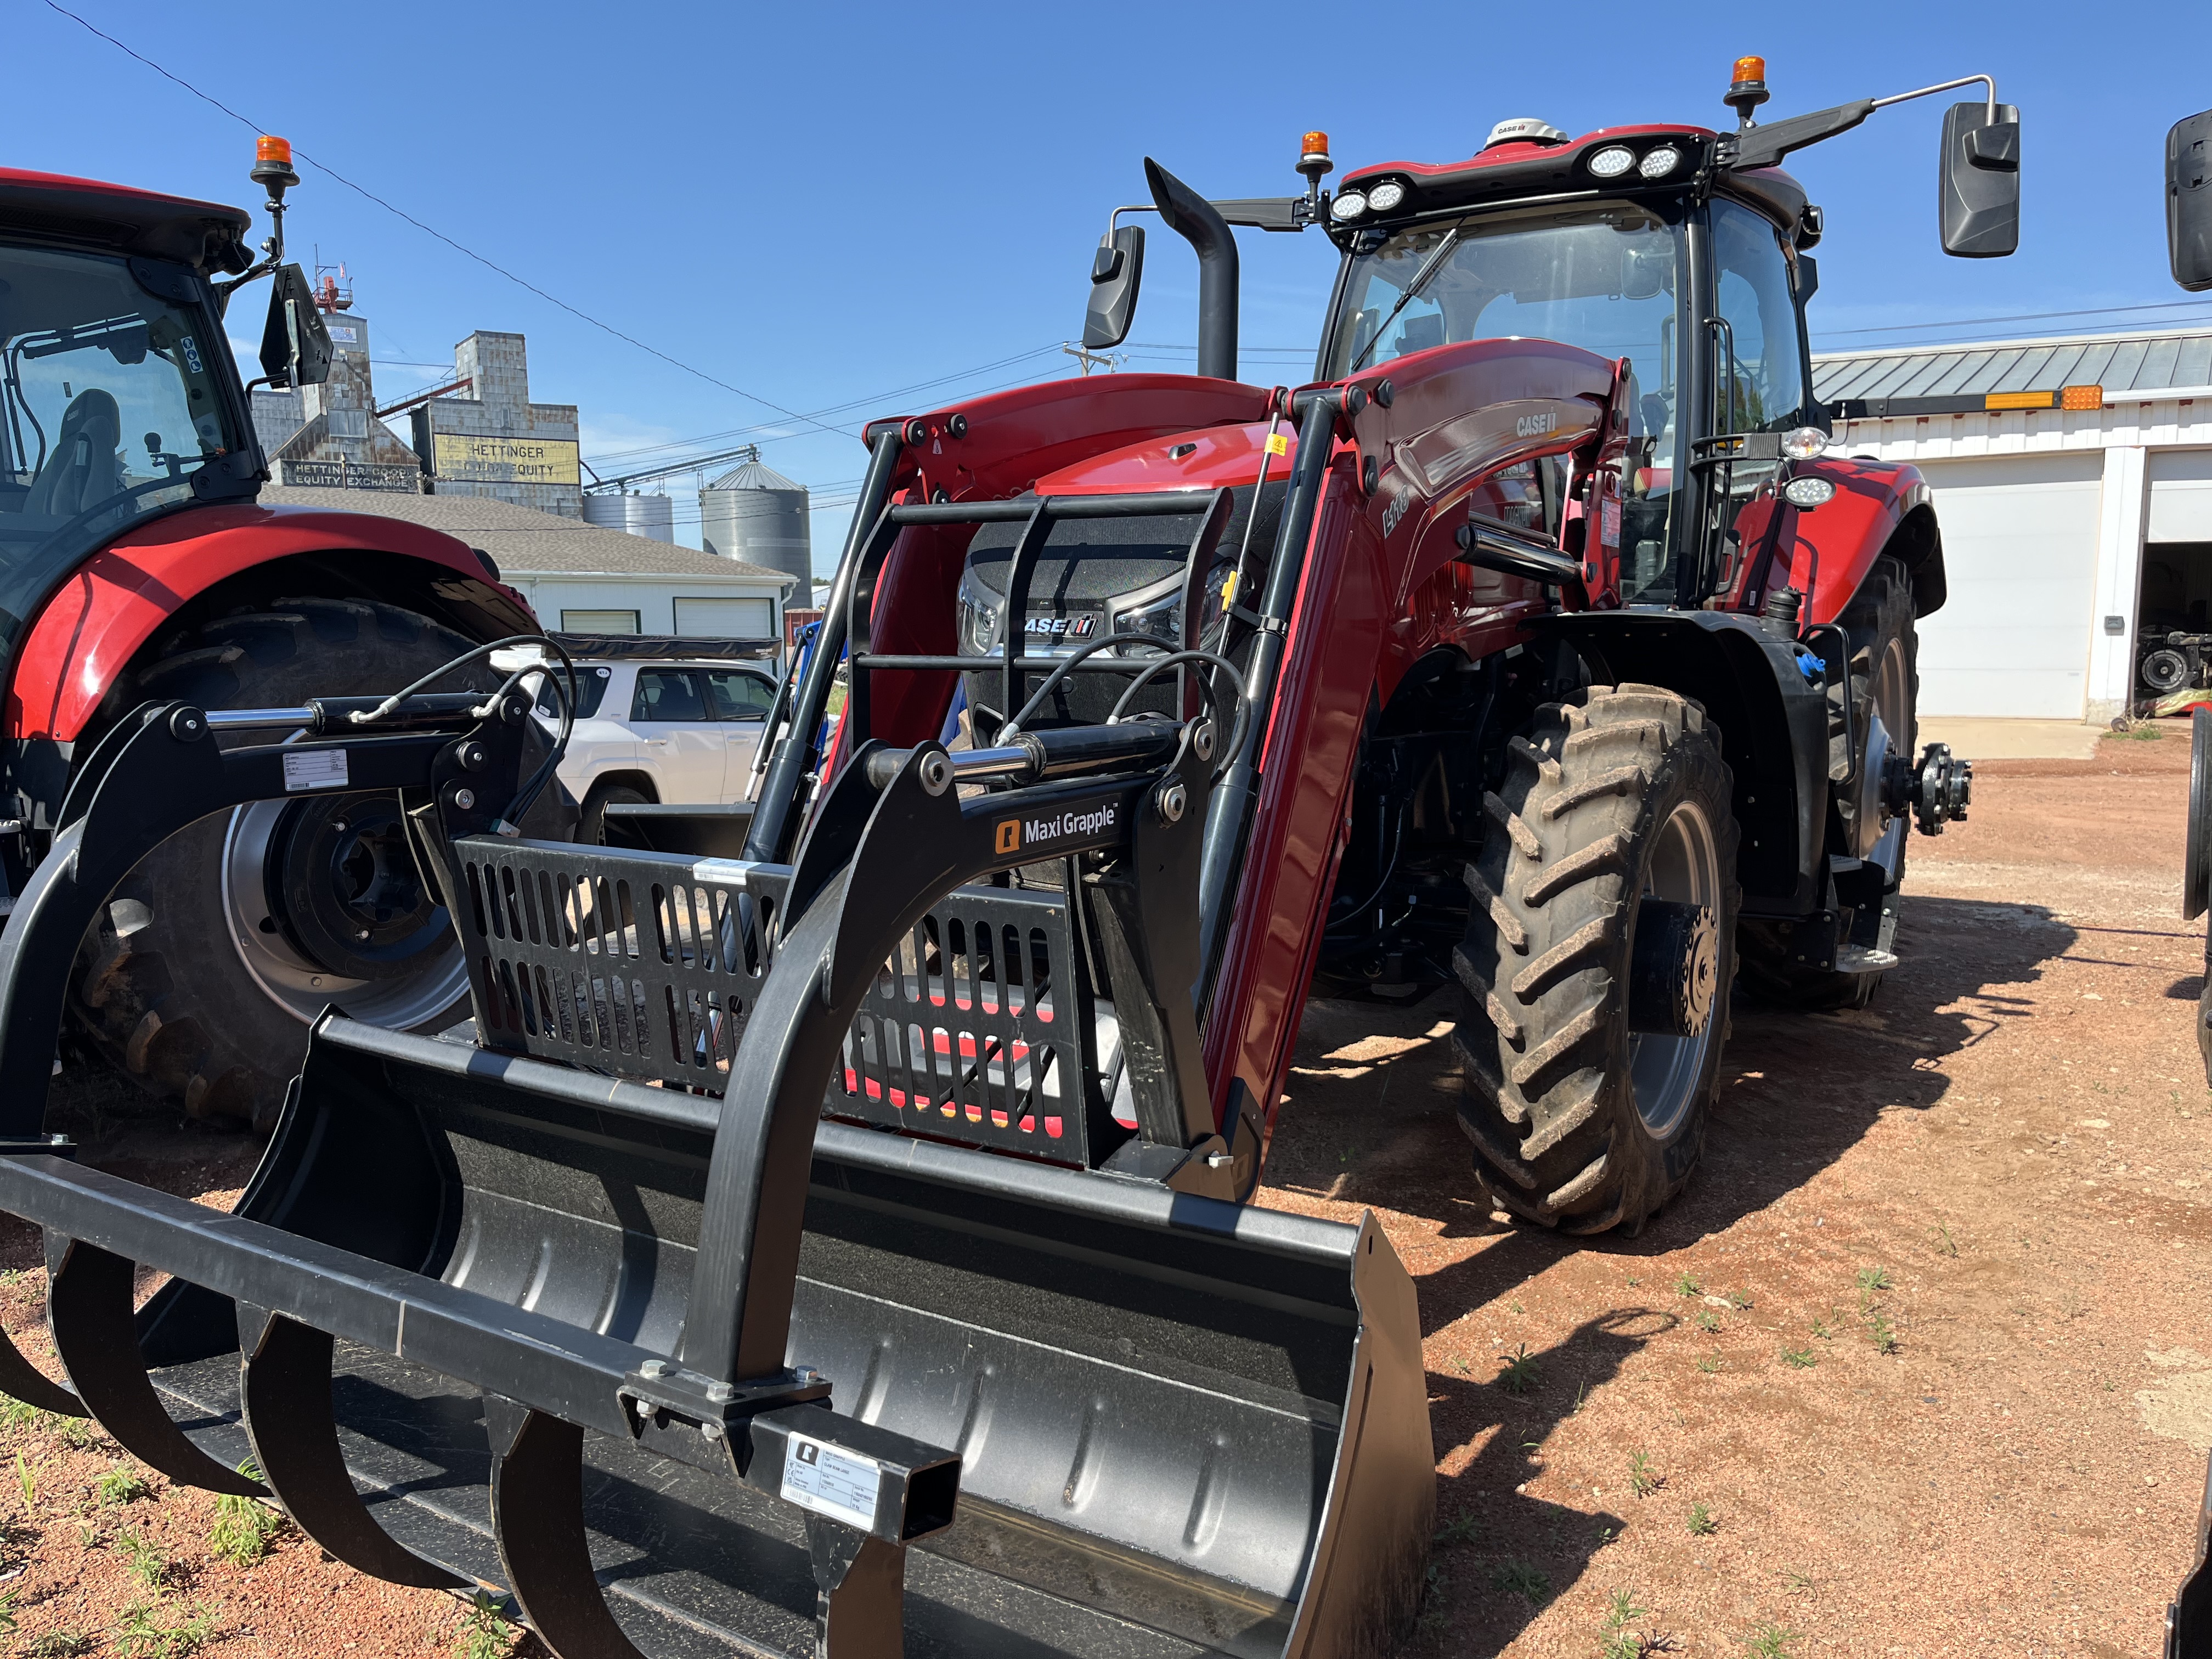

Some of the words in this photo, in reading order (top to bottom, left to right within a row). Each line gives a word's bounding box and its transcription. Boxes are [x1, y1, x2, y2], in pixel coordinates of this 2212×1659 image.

[1517, 414, 1546, 437] CASE
[472, 445, 544, 458] HETTINGER
[296, 476, 340, 485] EQUITY
[347, 477, 408, 487] EXCHANGE
[1025, 618, 1068, 633] ASE
[1025, 815, 1060, 843] Maxi
[1063, 805, 1114, 835] Grapple
